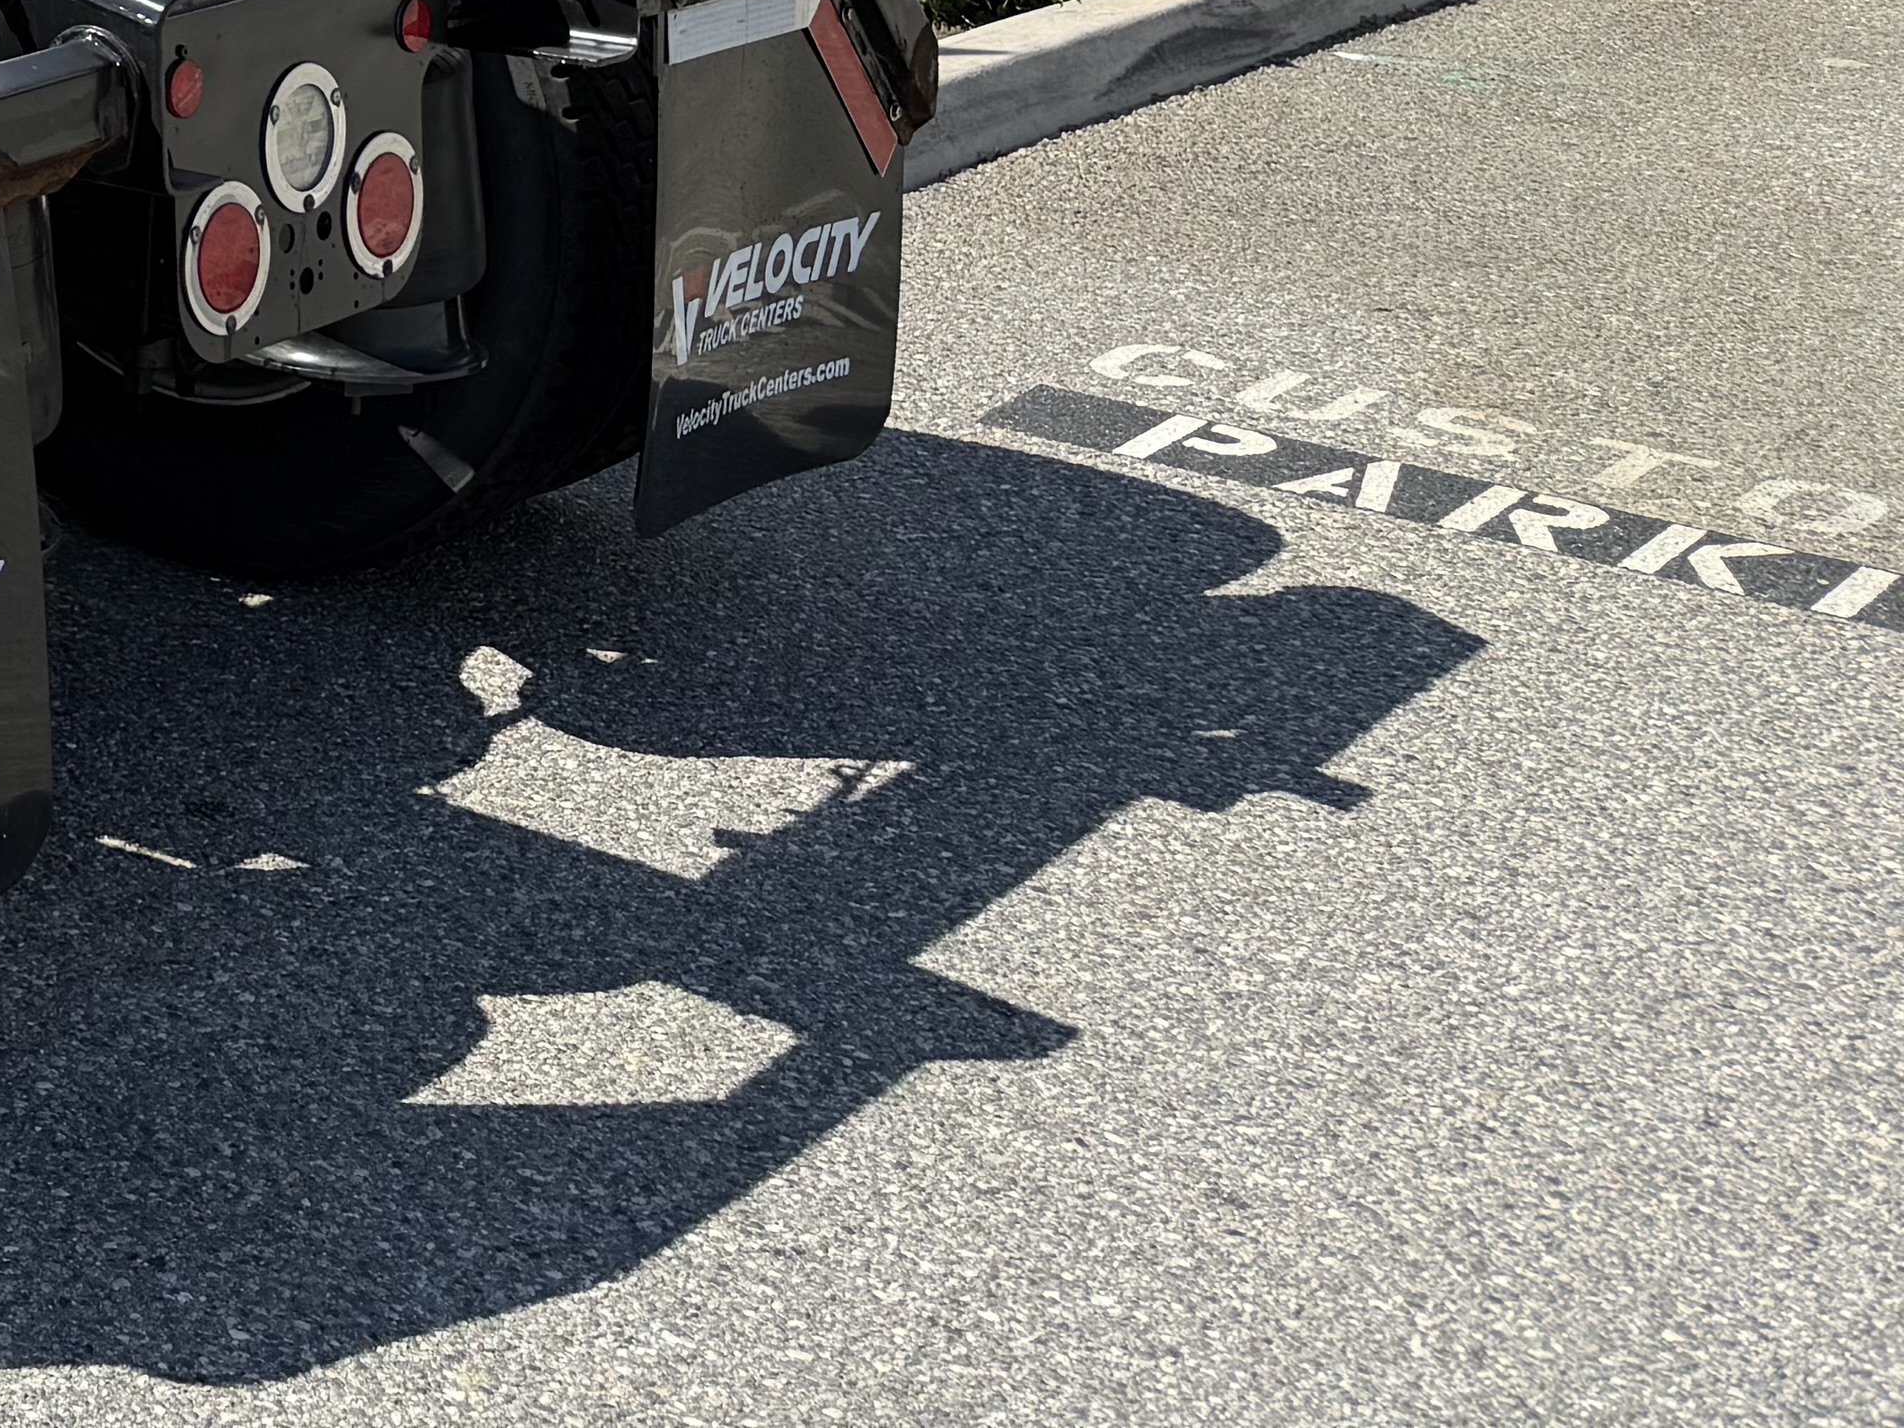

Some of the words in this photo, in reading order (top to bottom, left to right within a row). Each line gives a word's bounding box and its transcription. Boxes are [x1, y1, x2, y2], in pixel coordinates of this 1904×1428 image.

[703, 210, 882, 318] VELOCITY
[698, 318, 737, 356] TRUCK
[740, 294, 805, 337] CENTERS
[675, 355, 851, 441] VelocityTruckCenters.com
